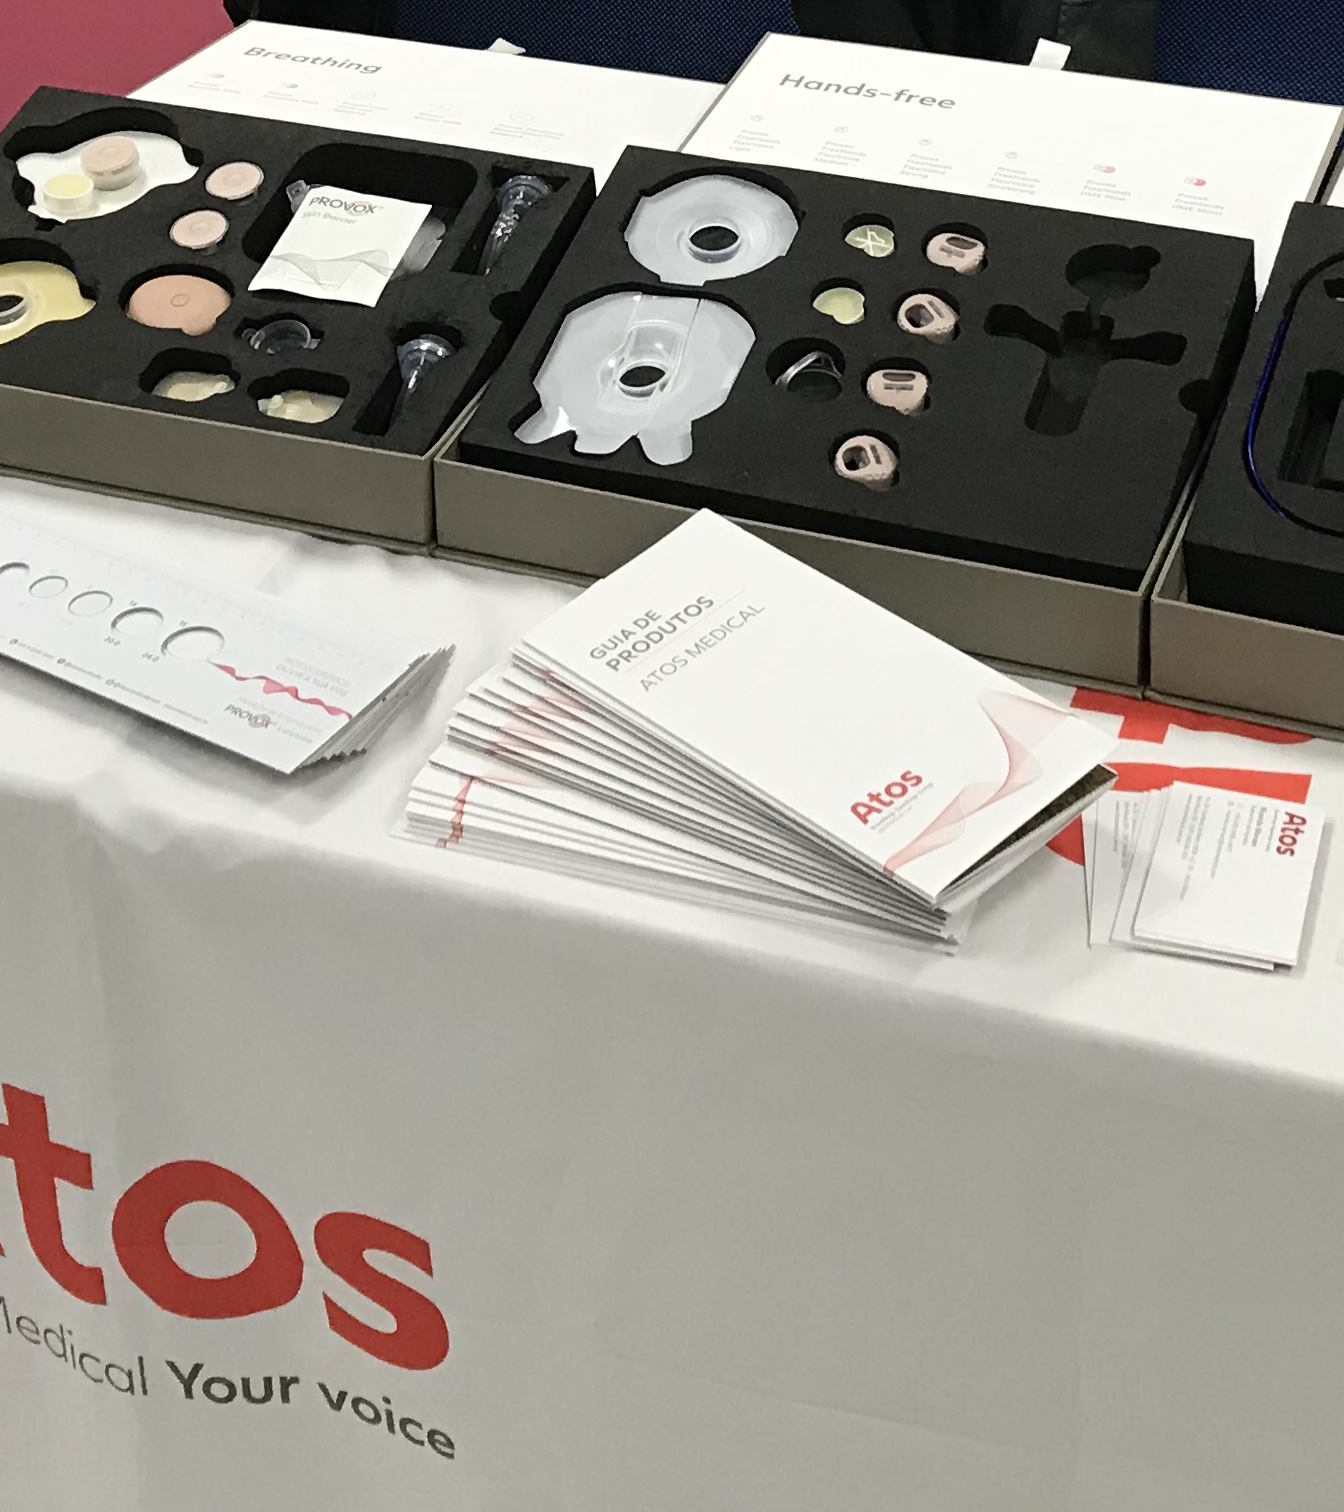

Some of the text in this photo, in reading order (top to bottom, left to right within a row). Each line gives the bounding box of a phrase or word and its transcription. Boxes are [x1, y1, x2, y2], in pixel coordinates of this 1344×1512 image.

[243, 46, 383, 75] Breathing
[778, 73, 956, 109] Hands-free
[309, 196, 377, 214] PROVOX
[589, 609, 662, 660] GUIA DE
[605, 595, 714, 672] PRODUTOS
[640, 604, 766, 691] ATOS MEDICAL
[850, 769, 923, 826] Atos
[1276, 811, 1307, 857] Atos
[165, 1359, 300, 1405] Your
[317, 1382, 456, 1460] voice
